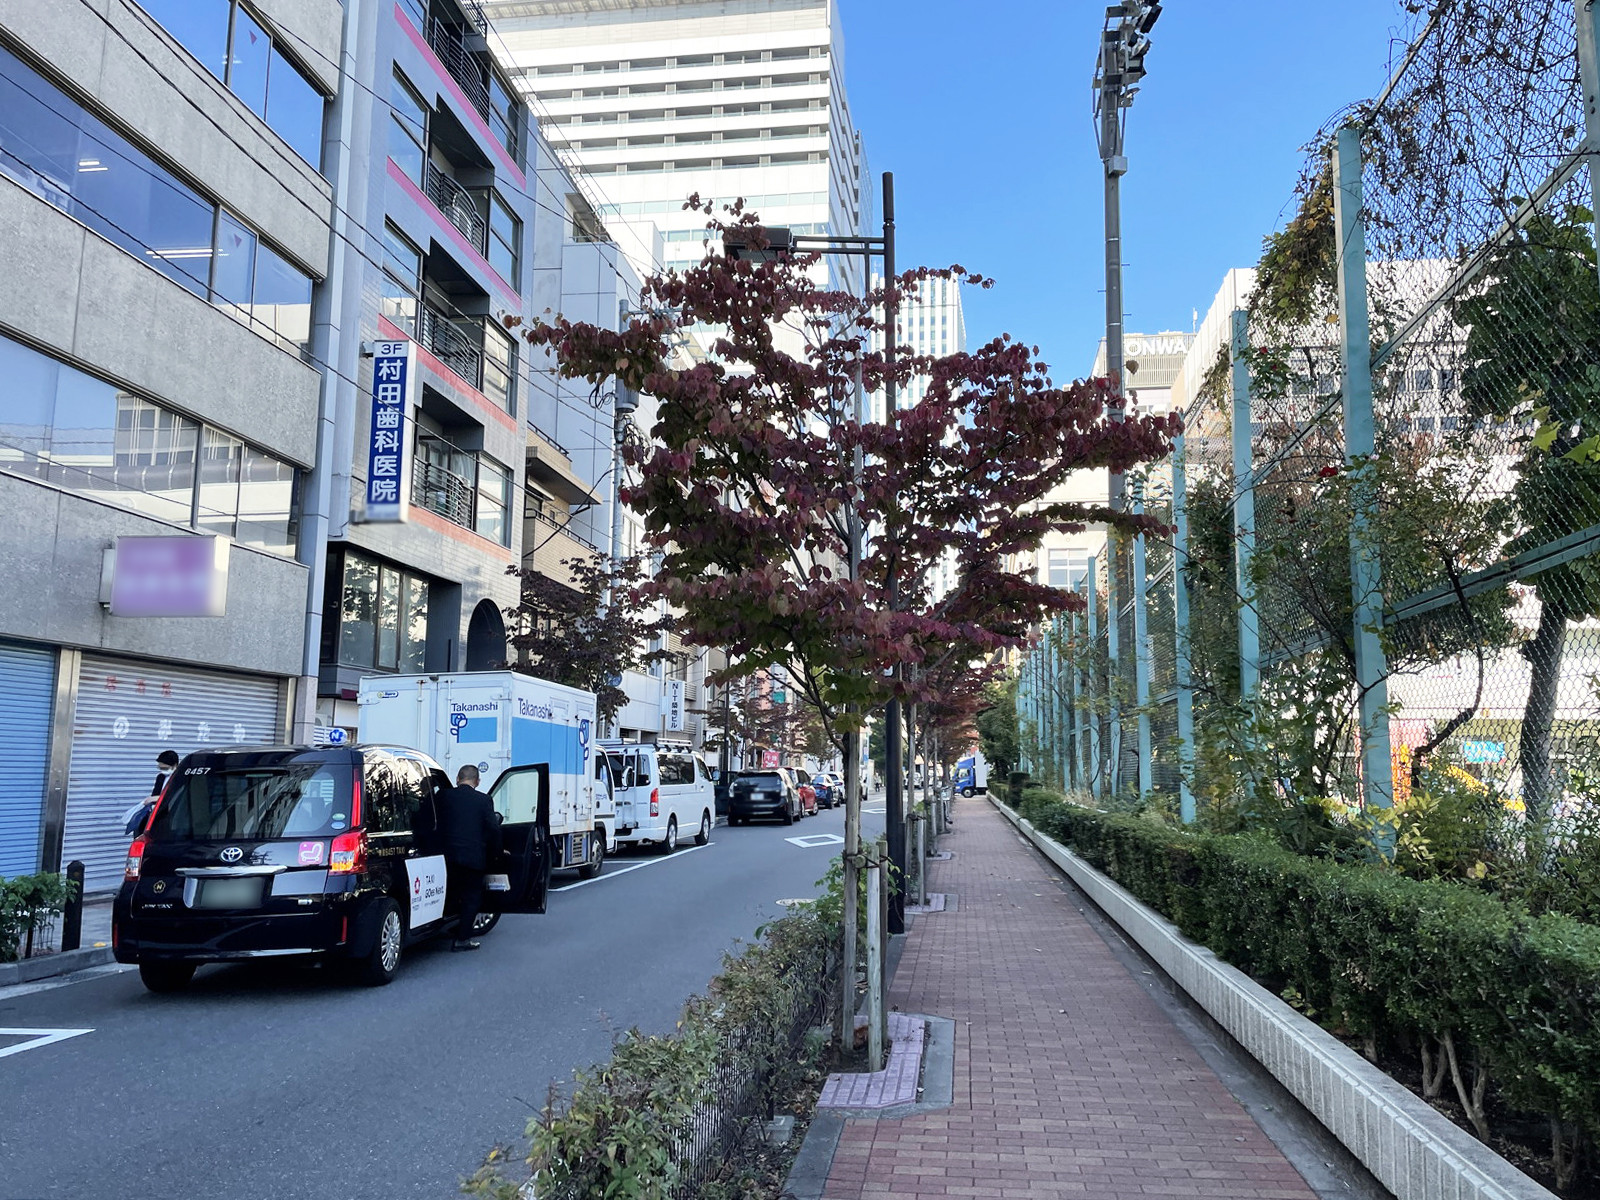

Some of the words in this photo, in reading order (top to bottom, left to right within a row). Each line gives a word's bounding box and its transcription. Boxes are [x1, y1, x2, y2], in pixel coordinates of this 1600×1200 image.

[381, 344, 402, 355] 3F
[371, 359, 403, 502] 村田歯科医院
[452, 702, 498, 712] Takanashi
[518, 698, 552, 719] Takanashi
[184, 767, 211, 776] 6457
